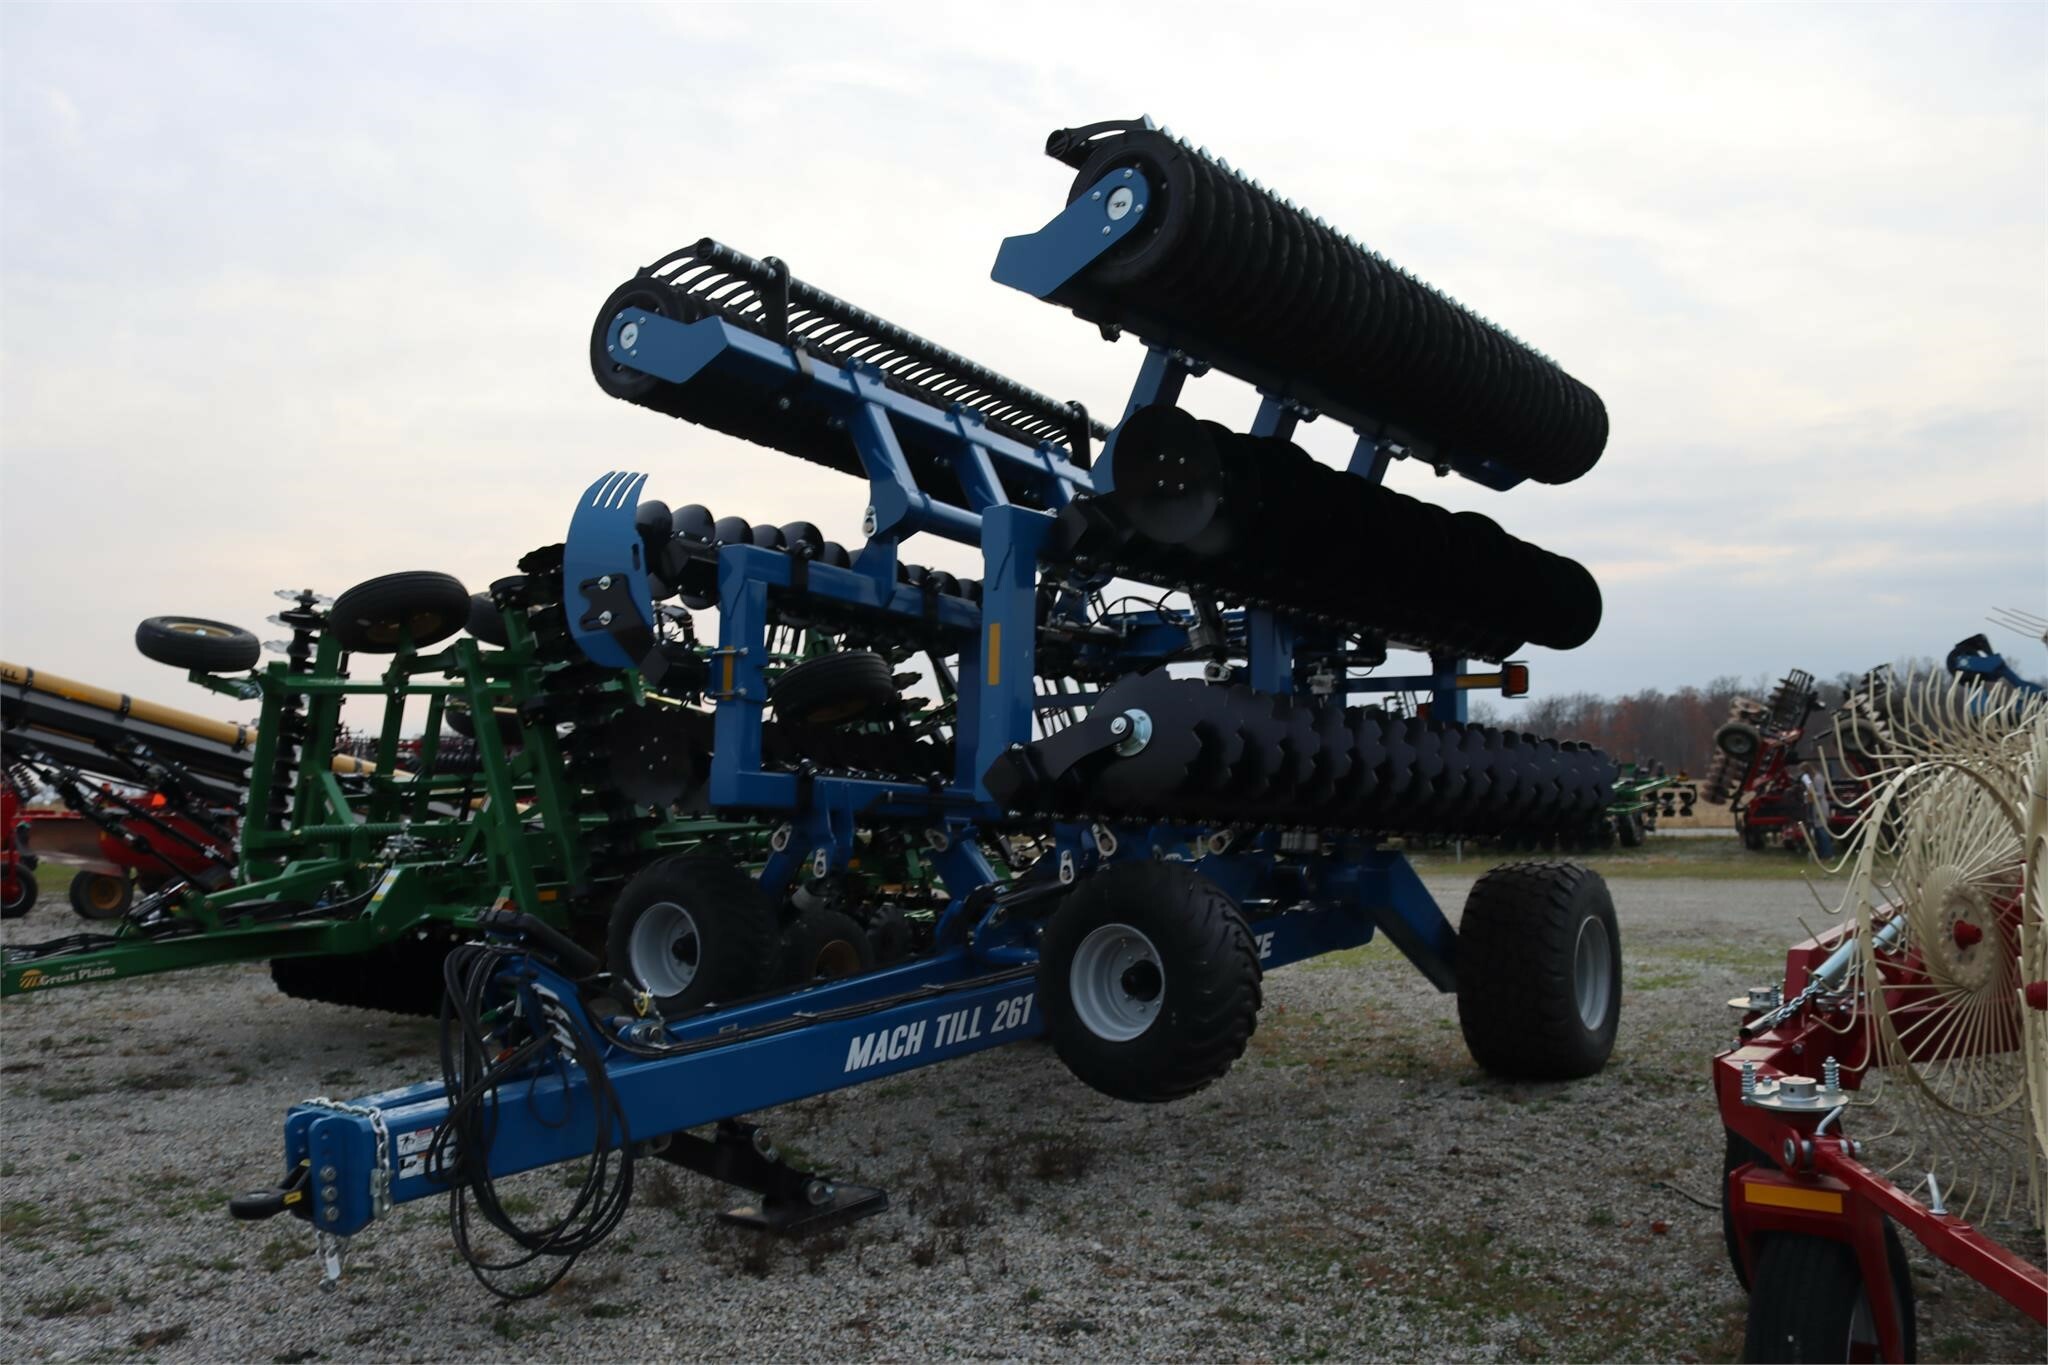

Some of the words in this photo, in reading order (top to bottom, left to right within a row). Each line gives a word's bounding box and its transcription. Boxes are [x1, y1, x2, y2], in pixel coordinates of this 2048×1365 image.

[40, 972, 76, 986] Great
[78, 966, 117, 980] Plains
[843, 1019, 928, 1073] MACH
[934, 1006, 982, 1049] TILL
[990, 993, 1035, 1034] 261
